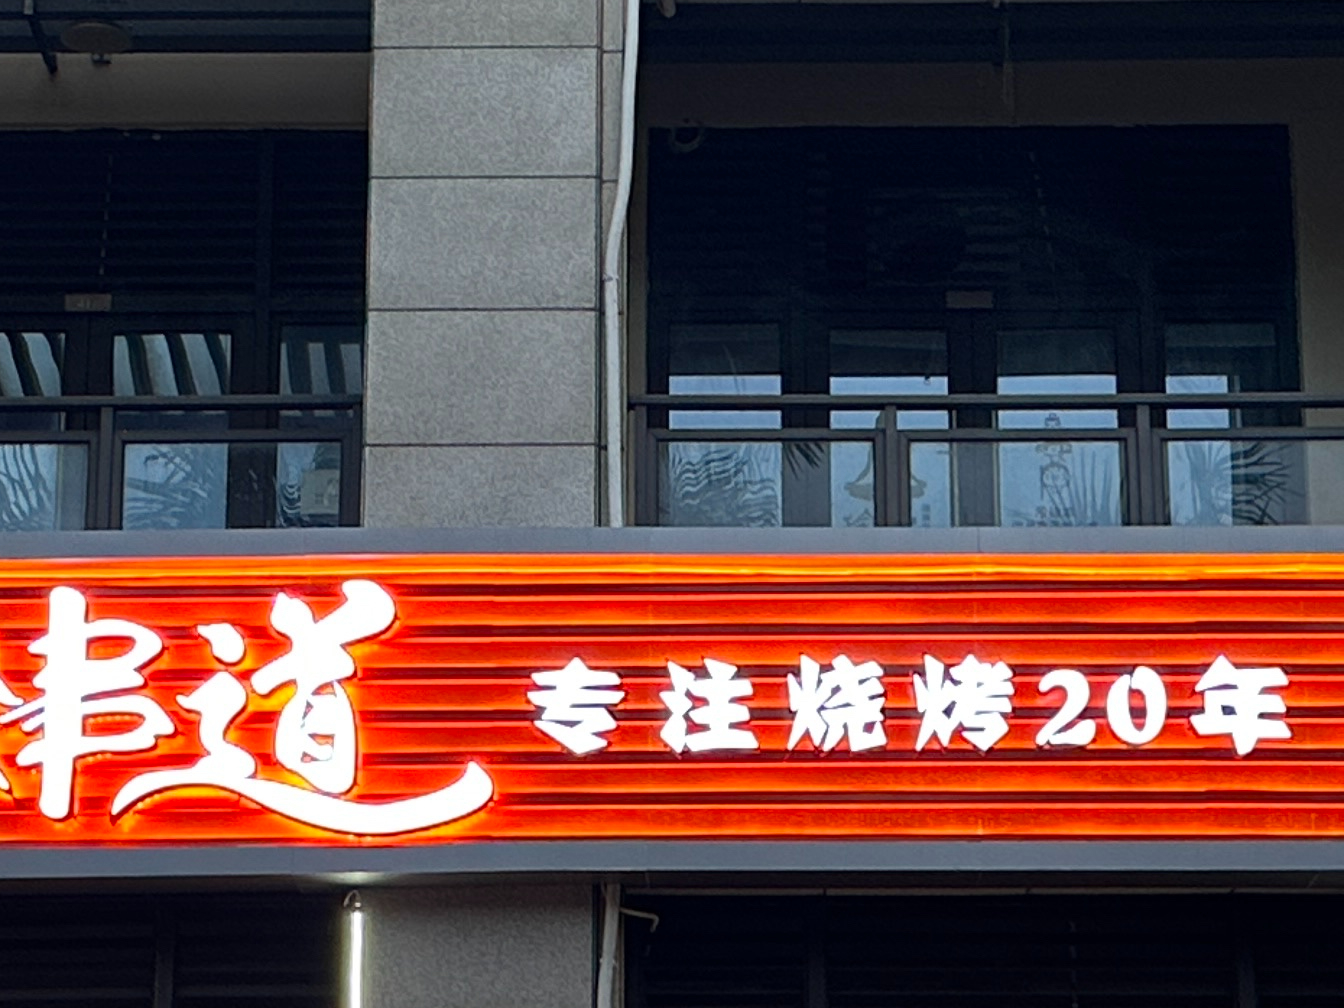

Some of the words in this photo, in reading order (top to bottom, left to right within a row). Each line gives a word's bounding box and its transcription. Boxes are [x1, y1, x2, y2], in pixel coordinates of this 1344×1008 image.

[526, 652, 1293, 756] 专注烧烤20年
